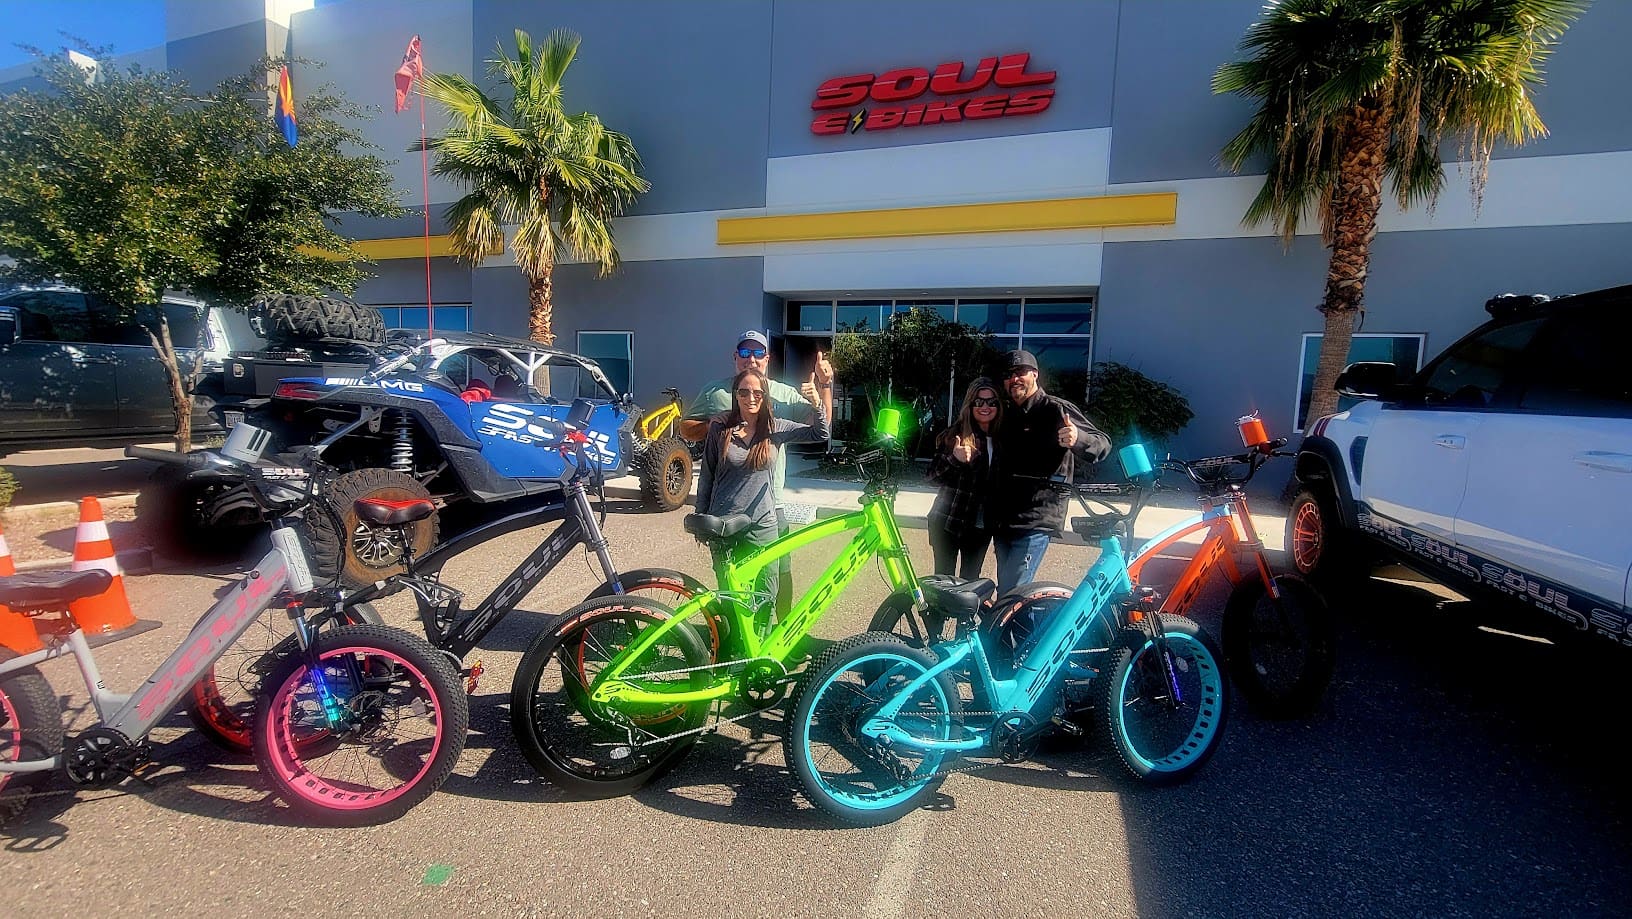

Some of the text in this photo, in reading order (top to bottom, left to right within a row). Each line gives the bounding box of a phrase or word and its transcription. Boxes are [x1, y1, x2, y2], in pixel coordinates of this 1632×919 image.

[811, 52, 1057, 111] SOUL
[864, 88, 1056, 131] BIKES
[464, 526, 581, 642] SOUL
[783, 536, 881, 648] SOUL
[1410, 534, 1481, 583] SOUL
[1481, 563, 1589, 631] SOUL
[136, 563, 287, 721] SOUL
[1026, 567, 1123, 703] SOUL
